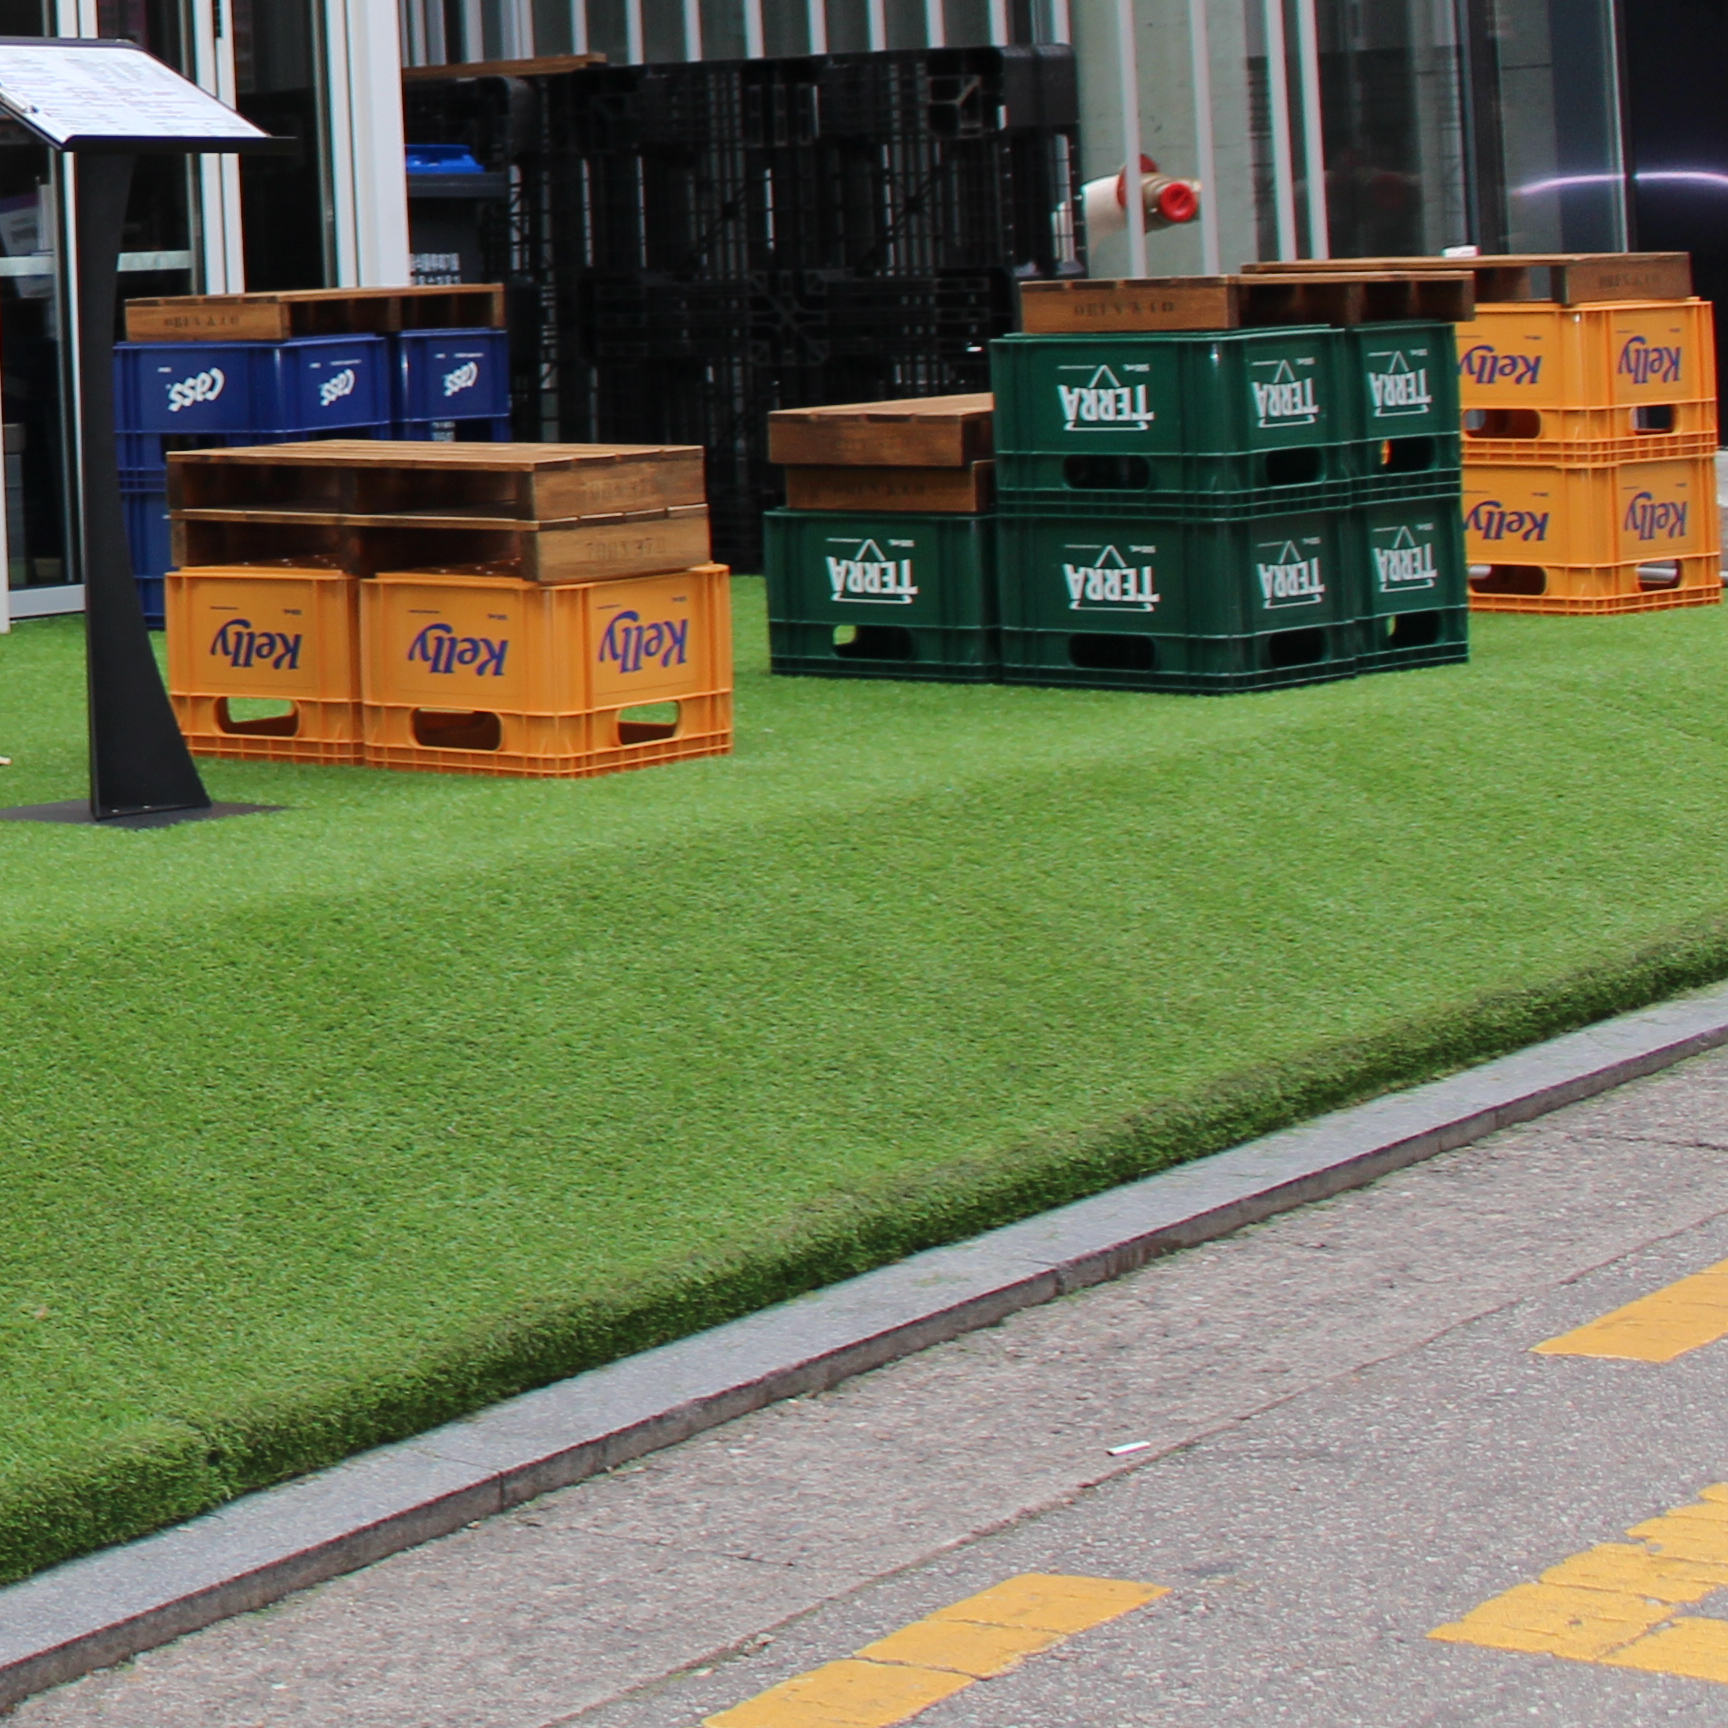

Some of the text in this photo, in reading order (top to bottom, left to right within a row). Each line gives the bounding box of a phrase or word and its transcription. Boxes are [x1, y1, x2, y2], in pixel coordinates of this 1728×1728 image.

[1058, 383, 1155, 423] TERRA
[1251, 378, 1319, 422] TERRA
[1368, 369, 1432, 413] TERRA
[826, 555, 919, 598] TERRA
[1257, 558, 1325, 602] TERRA
[1373, 537, 1438, 581] TERRA
[1063, 563, 1160, 605] TERRA
[210, 618, 302, 670] Kelly
[408, 622, 509, 678] Kelly
[599, 610, 689, 674] Kelly
